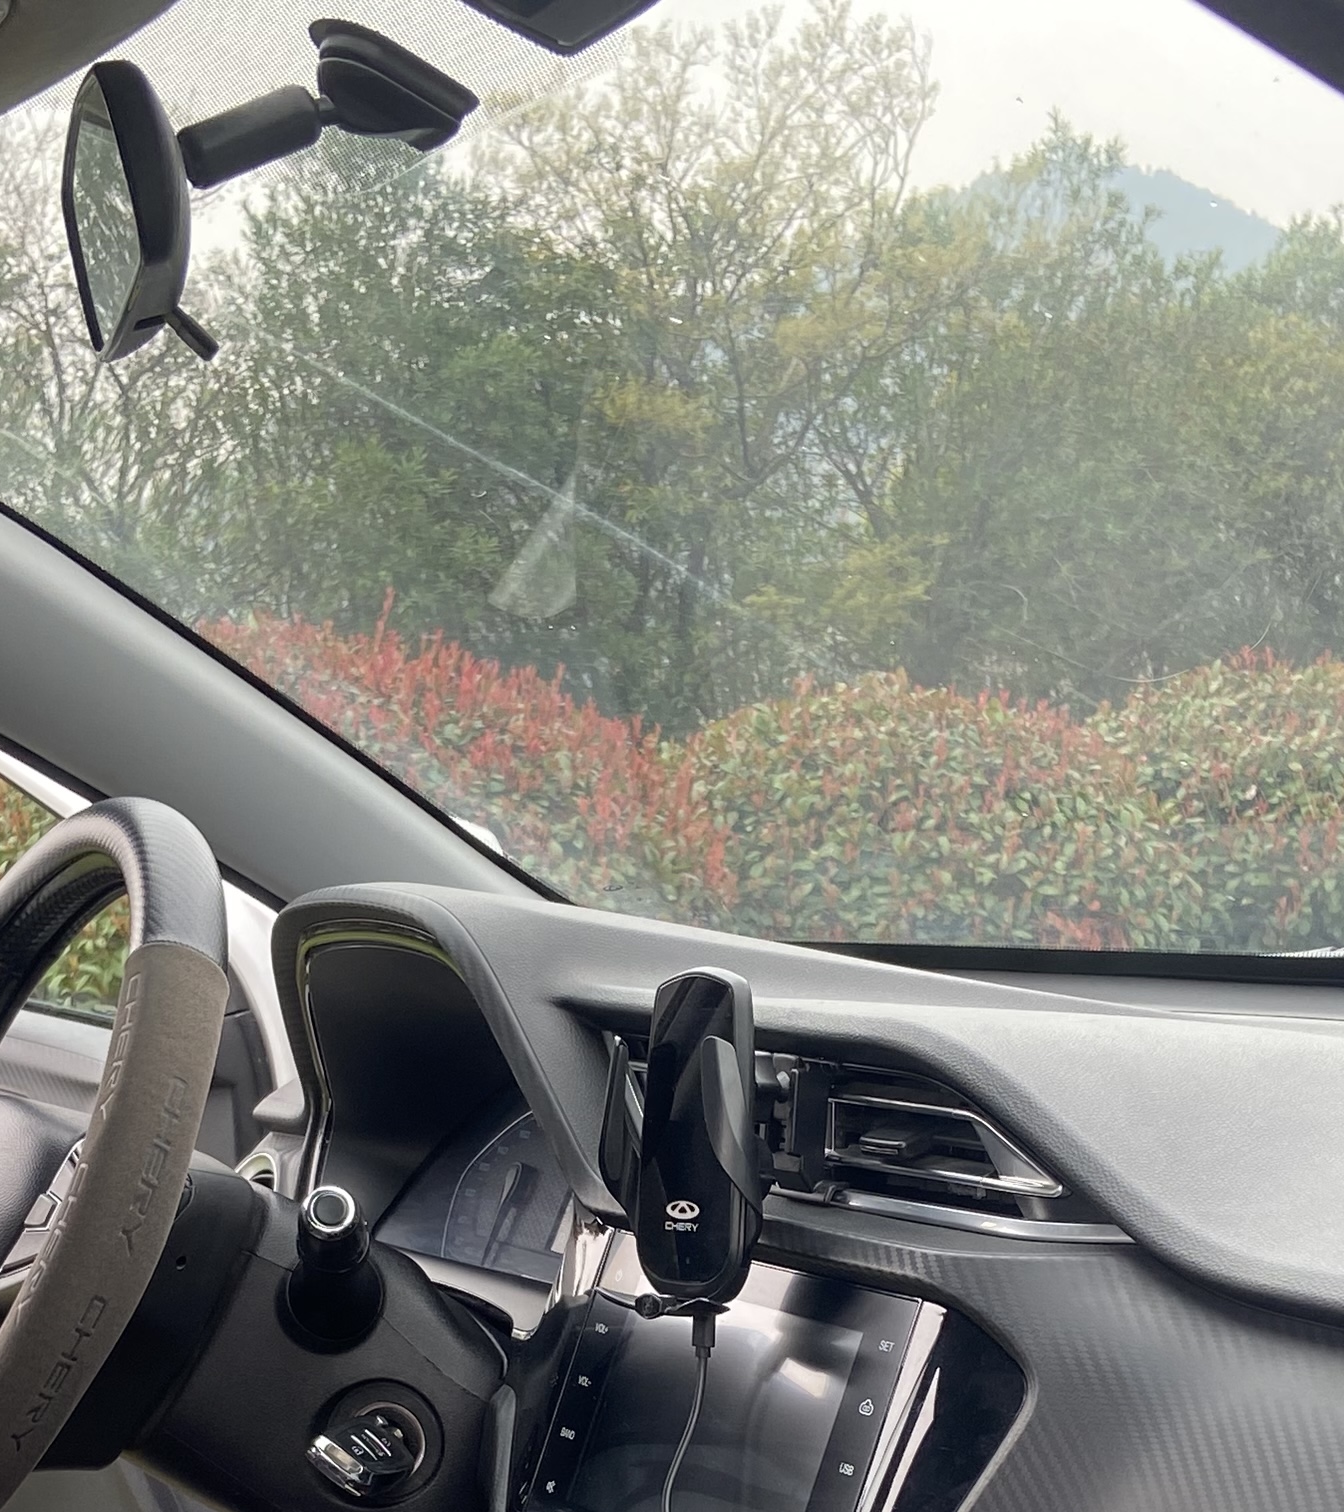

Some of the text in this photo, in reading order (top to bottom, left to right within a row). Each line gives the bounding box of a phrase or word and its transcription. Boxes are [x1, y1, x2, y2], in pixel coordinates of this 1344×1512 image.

[102, 973, 141, 1122] CHERY
[119, 1076, 188, 1258] CHERY
[664, 1221, 699, 1232] CHERY
[878, 1339, 896, 1353] SET
[9, 1295, 108, 1453] CHERY
[560, 1426, 576, 1440] BAND
[839, 1462, 855, 1477] USB
